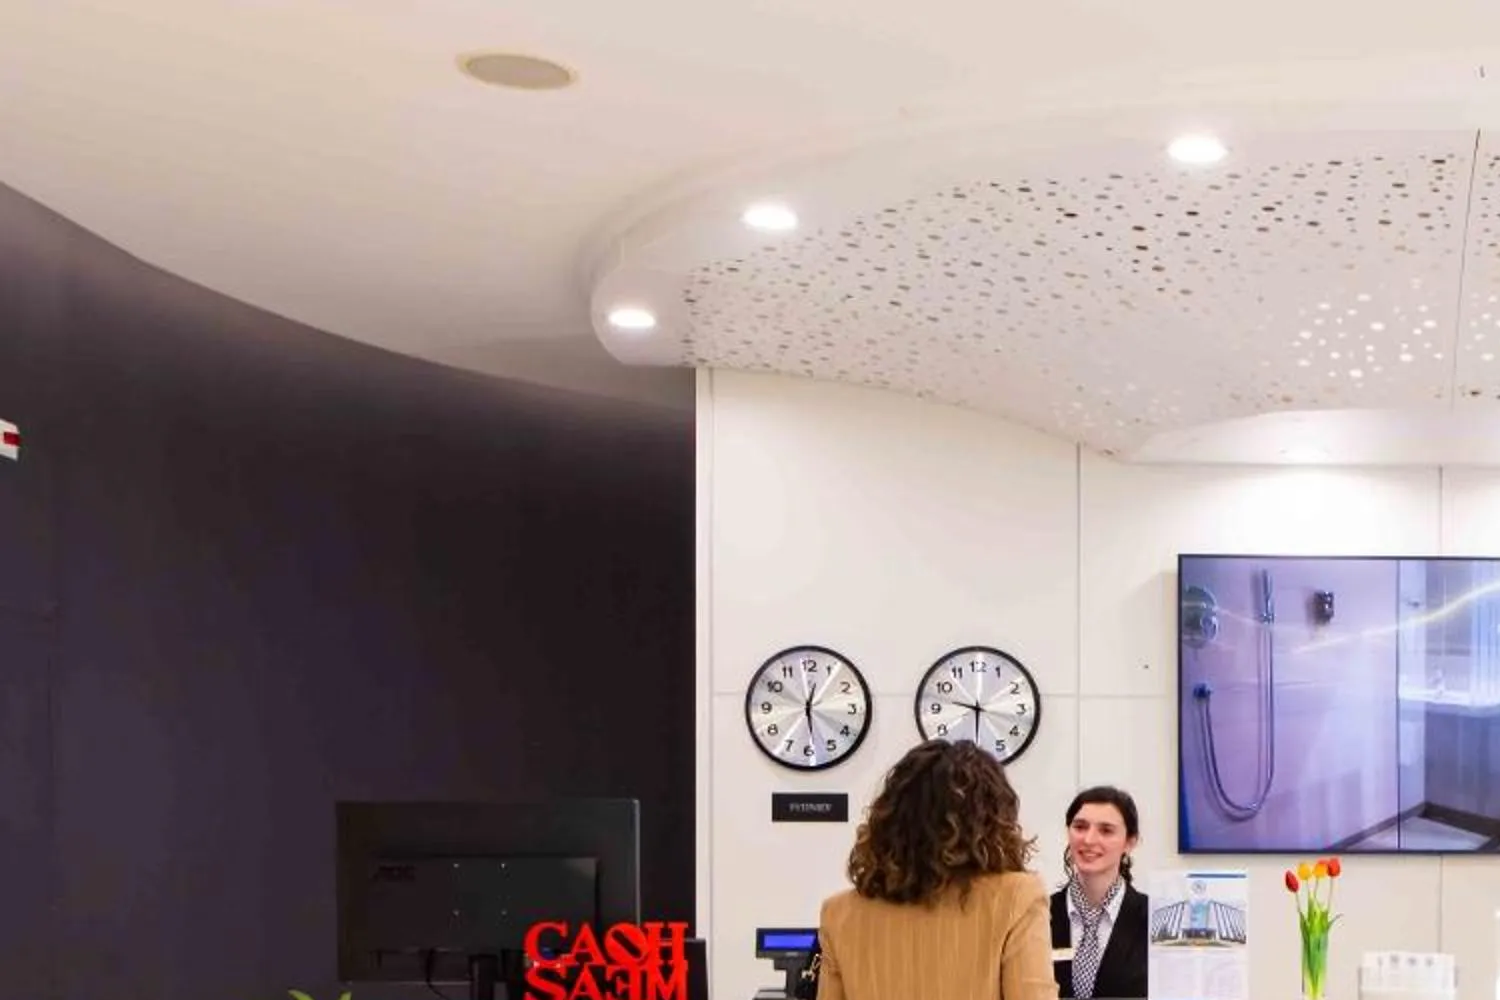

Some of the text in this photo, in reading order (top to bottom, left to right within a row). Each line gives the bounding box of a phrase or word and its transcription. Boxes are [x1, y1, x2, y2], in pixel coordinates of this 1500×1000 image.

[782, 666, 793, 678] 11
[802, 660, 817, 672] 12
[970, 660, 987, 673] 12
[952, 667, 963, 679] 11
[767, 681, 783, 693] 10
[840, 682, 851, 693] 2
[936, 681, 952, 694] 10
[1009, 681, 1020, 694] 2
[761, 702, 772, 714] 9
[847, 703, 856, 715] 3
[931, 703, 942, 714] 9
[767, 724, 778, 735] 8
[840, 725, 850, 736] 4
[937, 724, 948, 736] 8
[1009, 725, 1019, 736] 4
[785, 740, 794, 751] 7
[803, 745, 814, 756] 6
[826, 740, 837, 751] 5
[995, 740, 1006, 752] 5
